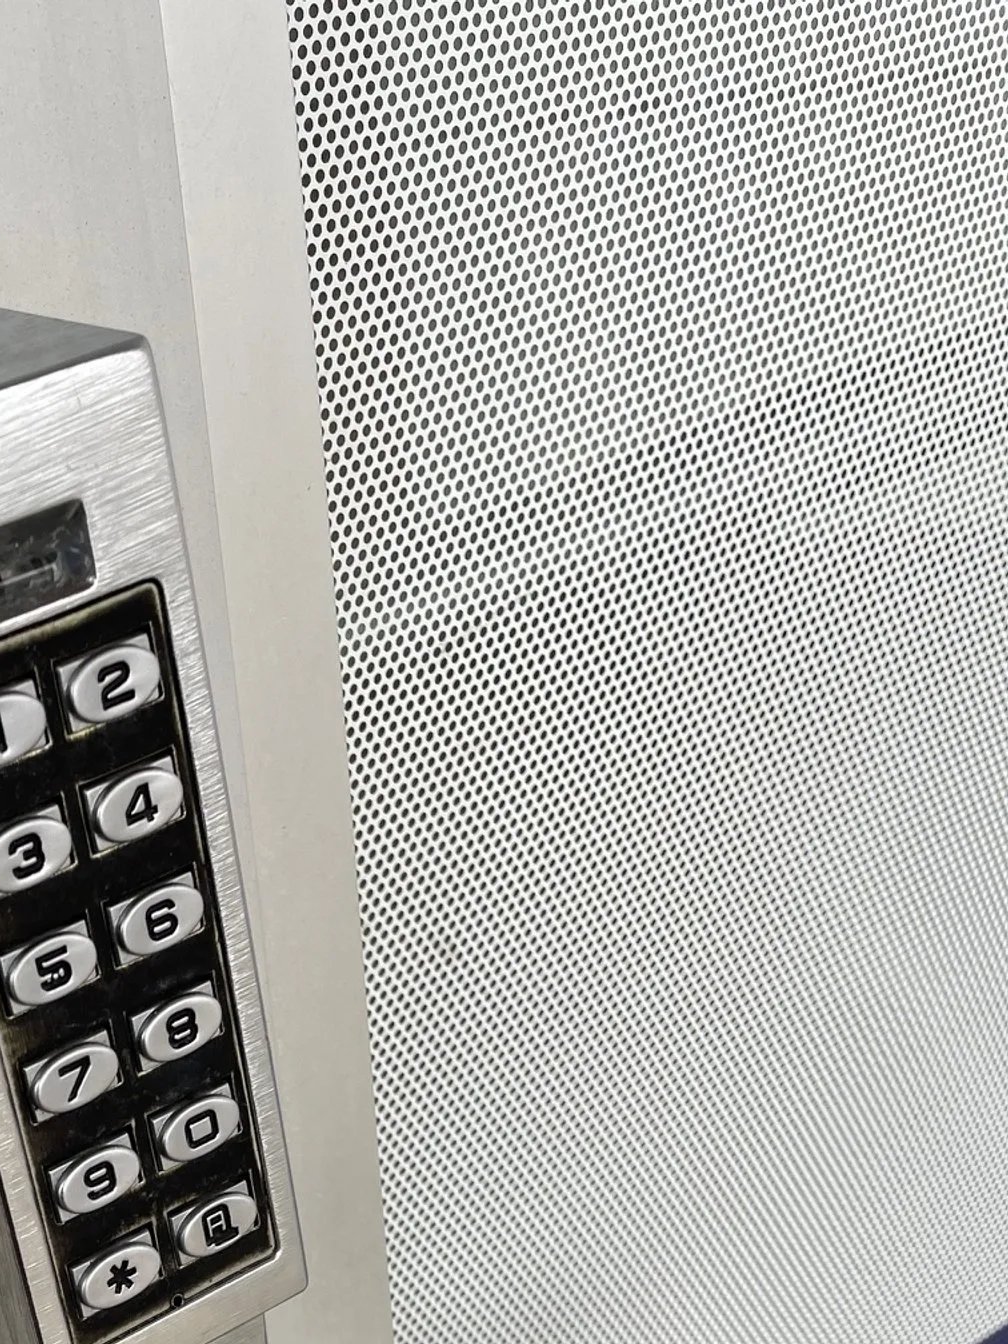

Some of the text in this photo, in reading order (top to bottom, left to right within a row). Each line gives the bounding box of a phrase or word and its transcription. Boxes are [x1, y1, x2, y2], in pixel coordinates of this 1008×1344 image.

[97, 660, 136, 712] 2
[7, 781, 159, 880] 3 4
[34, 898, 179, 992] 5 6
[58, 1007, 199, 1103] 7 8
[83, 1107, 220, 1201] 9 0
